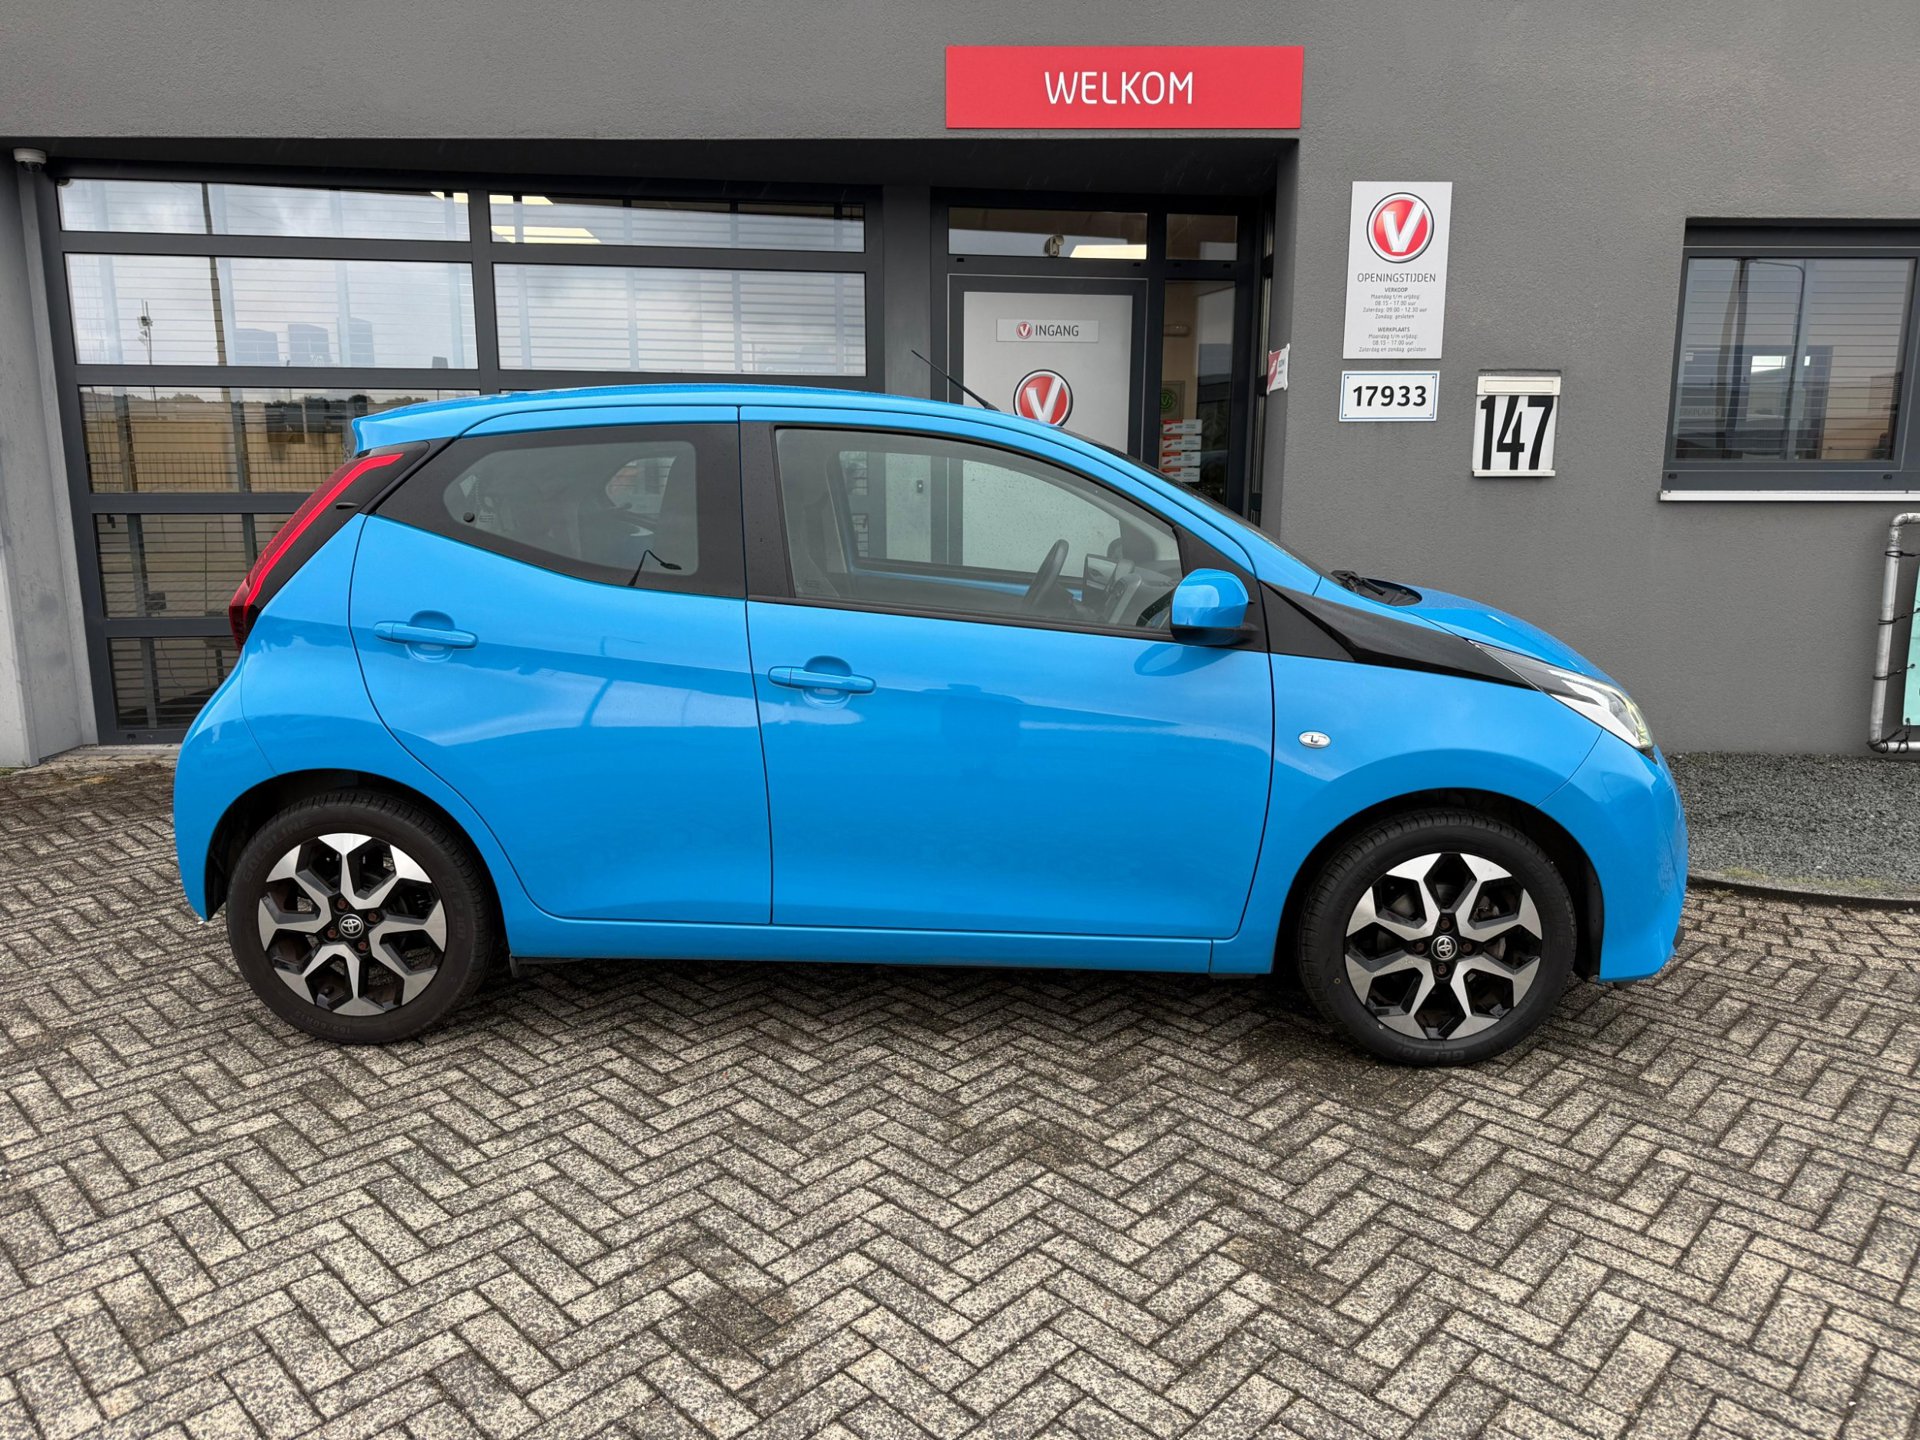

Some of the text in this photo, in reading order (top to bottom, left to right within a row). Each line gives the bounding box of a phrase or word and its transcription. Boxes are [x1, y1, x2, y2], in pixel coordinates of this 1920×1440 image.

[1044, 71, 1194, 105] WELKOM
[1381, 197, 1428, 253] V
[1357, 272, 1436, 282] OPENINGSTIJDEN
[1035, 324, 1079, 337] INGANG
[1352, 385, 1427, 407] 17933
[1480, 395, 1554, 470] 147
